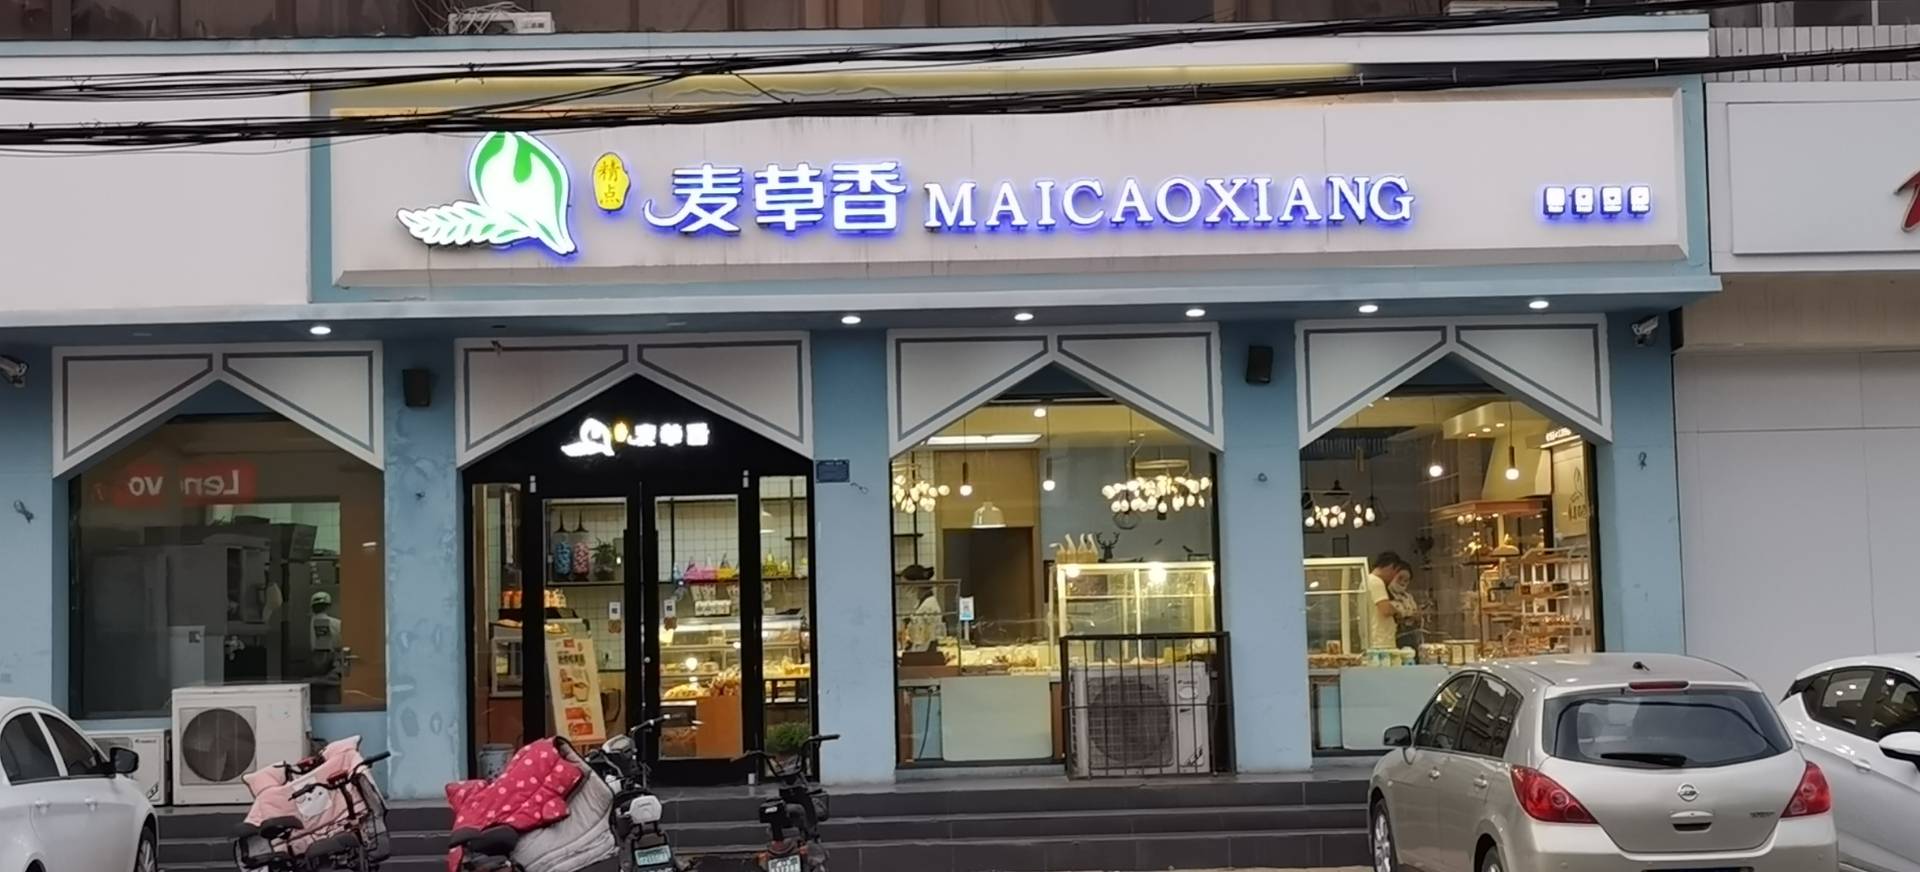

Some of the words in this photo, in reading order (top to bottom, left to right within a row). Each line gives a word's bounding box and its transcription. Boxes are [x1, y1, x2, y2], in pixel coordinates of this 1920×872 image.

[643, 161, 906, 233] 麦草香
[924, 175, 1415, 228] MAICAOXIANG
